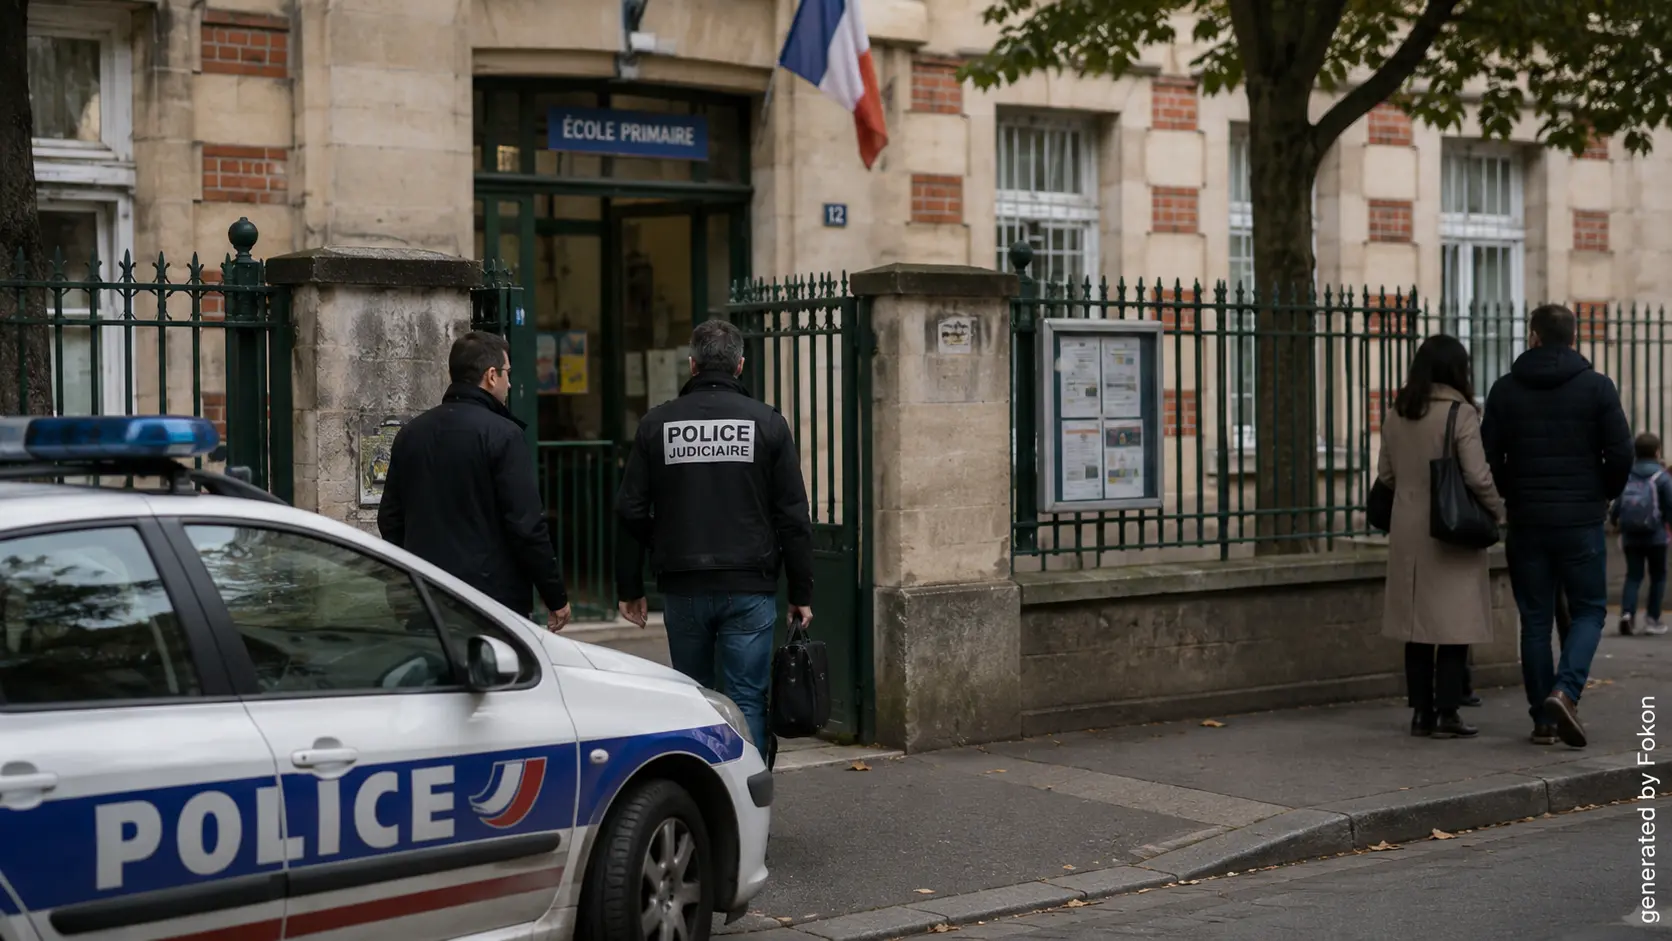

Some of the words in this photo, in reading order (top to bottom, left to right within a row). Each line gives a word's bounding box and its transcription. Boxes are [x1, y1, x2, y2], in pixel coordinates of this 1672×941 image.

[562, 114, 616, 142] ÉCOLE
[620, 122, 695, 147] PRIMAIRE
[828, 206, 845, 224] 12
[668, 424, 750, 444] POLICE
[669, 445, 750, 459] JUDICIAIRE
[94, 764, 457, 891] POLICE
